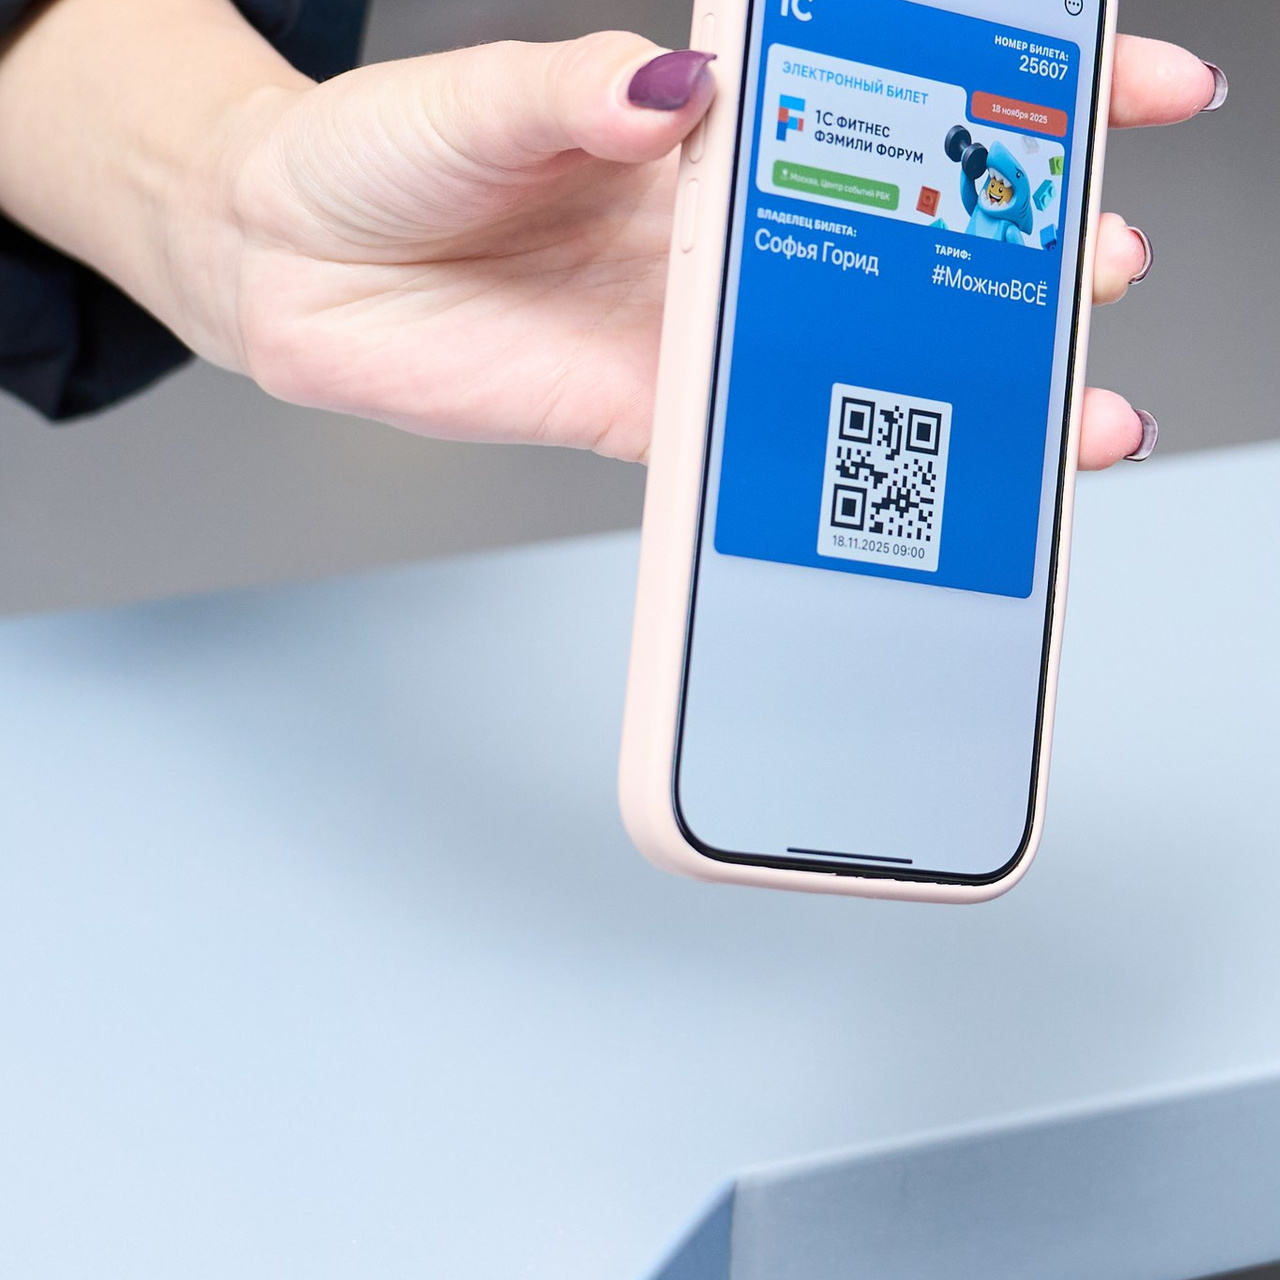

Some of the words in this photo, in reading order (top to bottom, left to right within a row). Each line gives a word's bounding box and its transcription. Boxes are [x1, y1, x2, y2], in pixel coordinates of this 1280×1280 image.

[994, 34, 1028, 52] НОМЕР
[1029, 42, 1069, 63] БИЛЕТА:
[1019, 55, 1068, 81] 25607
[782, 61, 883, 95] ЭЛЕКТРОННЫЙ
[886, 85, 929, 105] БИЛЕТ
[836, 116, 890, 138] ФИТНЕС
[992, 103, 1002, 115] 18
[1003, 105, 1028, 120] ноября
[1029, 110, 1048, 125] 2025
[814, 130, 873, 153] ФЭМИЛИ
[876, 143, 924, 164] ФОРУМ
[789, 172, 819, 187] Москва,
[820, 178, 843, 192] Центр
[844, 184, 875, 197] событий
[875, 190, 890, 201] РБК
[757, 207, 813, 229] ВЛАДЕЛЕЦ
[814, 219, 857, 237] БИЛЕТА:
[754, 228, 818, 260] Софья
[822, 241, 880, 276] Горид
[935, 244, 971, 261] ТАРИФ:
[932, 264, 1048, 306] #МожноВСЁ
[832, 534, 890, 556] 18.11.2025
[892, 543, 925, 560] 09:00
